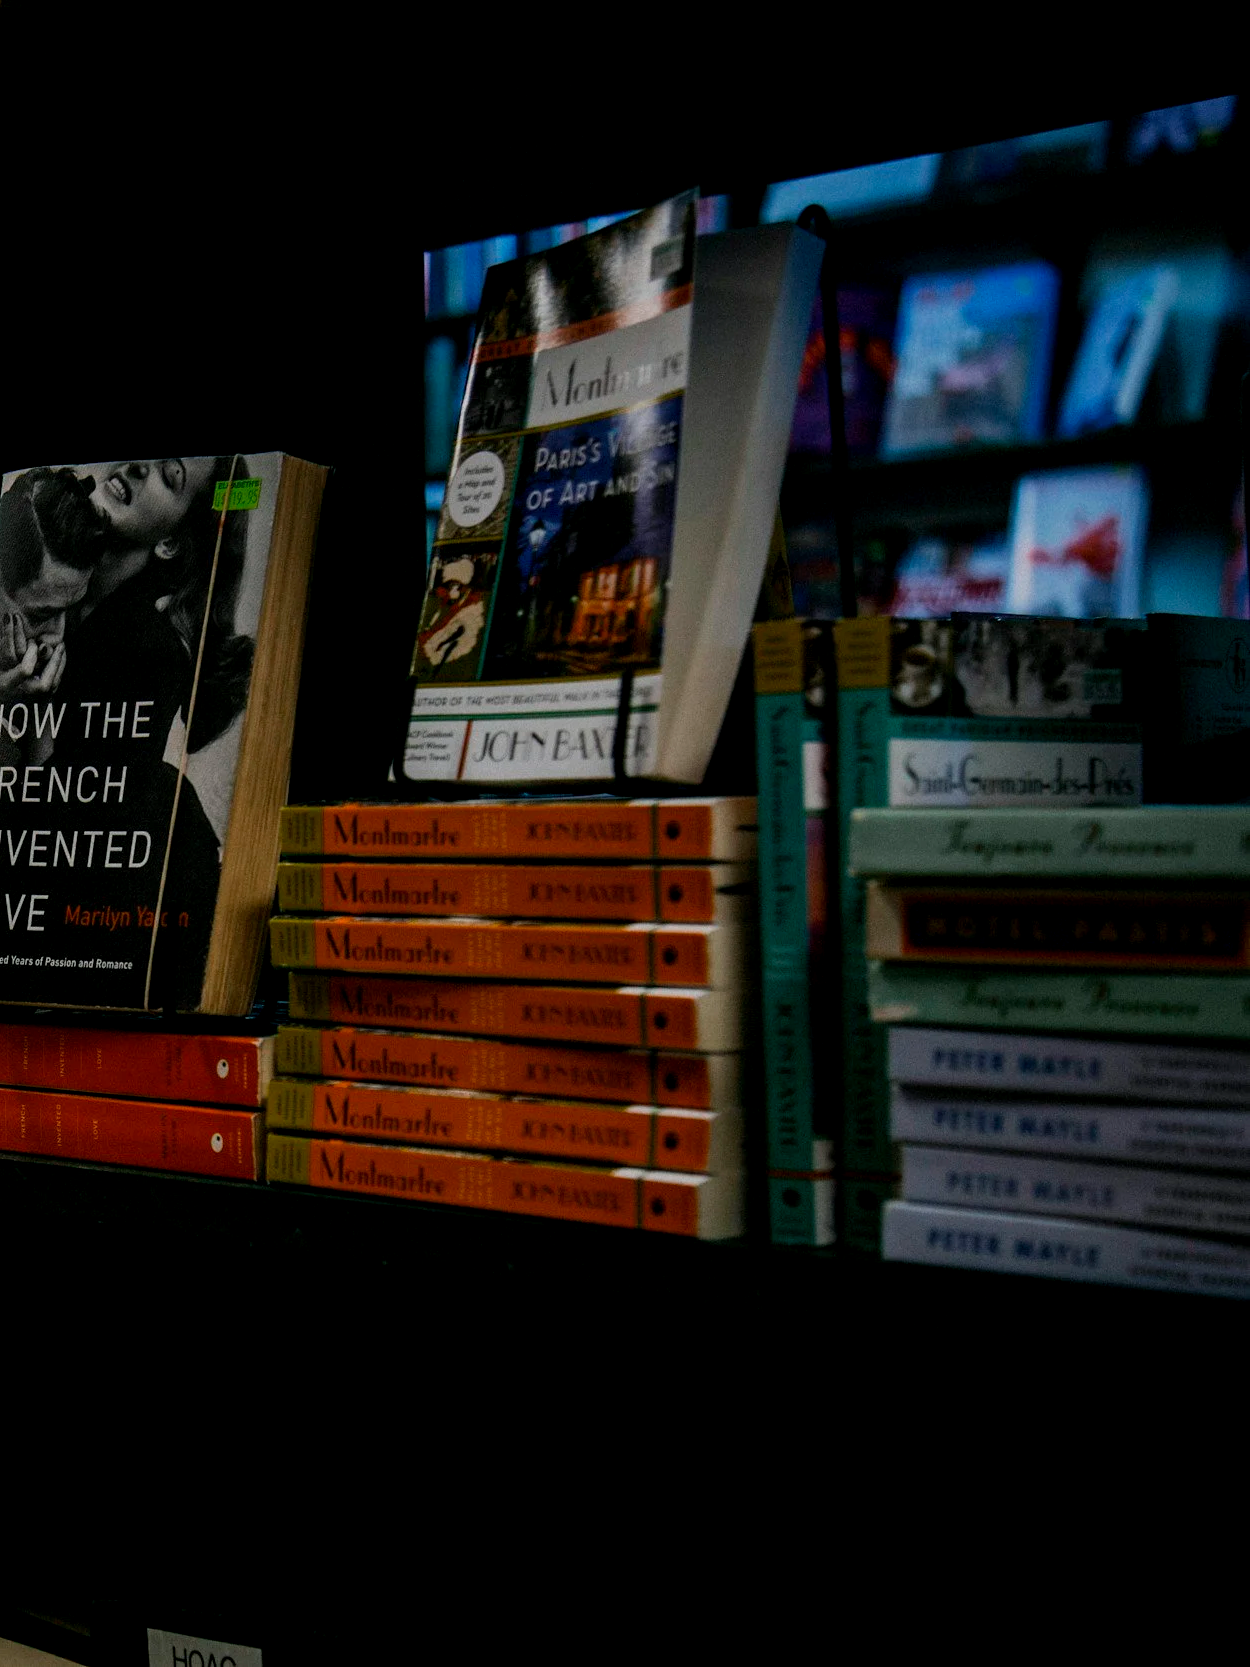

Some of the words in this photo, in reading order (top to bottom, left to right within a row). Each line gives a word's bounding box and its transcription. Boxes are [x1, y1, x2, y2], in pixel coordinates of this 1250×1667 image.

[80, 700, 155, 739] THE
[472, 730, 548, 763] JOHN
[334, 814, 461, 847] Montmartre
[334, 872, 462, 907] Montmartre
[64, 904, 132, 932] Marilyn
[10, 955, 34, 966] Years
[34, 956, 44, 967] of
[44, 957, 77, 968] Passion
[77, 958, 94, 968] and
[95, 959, 133, 970] Romance
[325, 928, 455, 965] Montmartre
[338, 992, 461, 1030] Montmartre
[332, 1040, 461, 1082] Montmartre
[934, 1049, 1002, 1073] PETER
[1018, 1052, 1100, 1080] MAYLE
[324, 1094, 453, 1137] Montmartre
[932, 1108, 1002, 1133] PETER
[1018, 1116, 1098, 1143] MAYLE
[320, 1150, 445, 1197] Montmartre
[947, 1171, 1019, 1196] PETER
[1033, 1180, 1114, 1207] MAYLE
[927, 1228, 999, 1253] PETER
[1014, 1240, 1100, 1268] MAYLE
